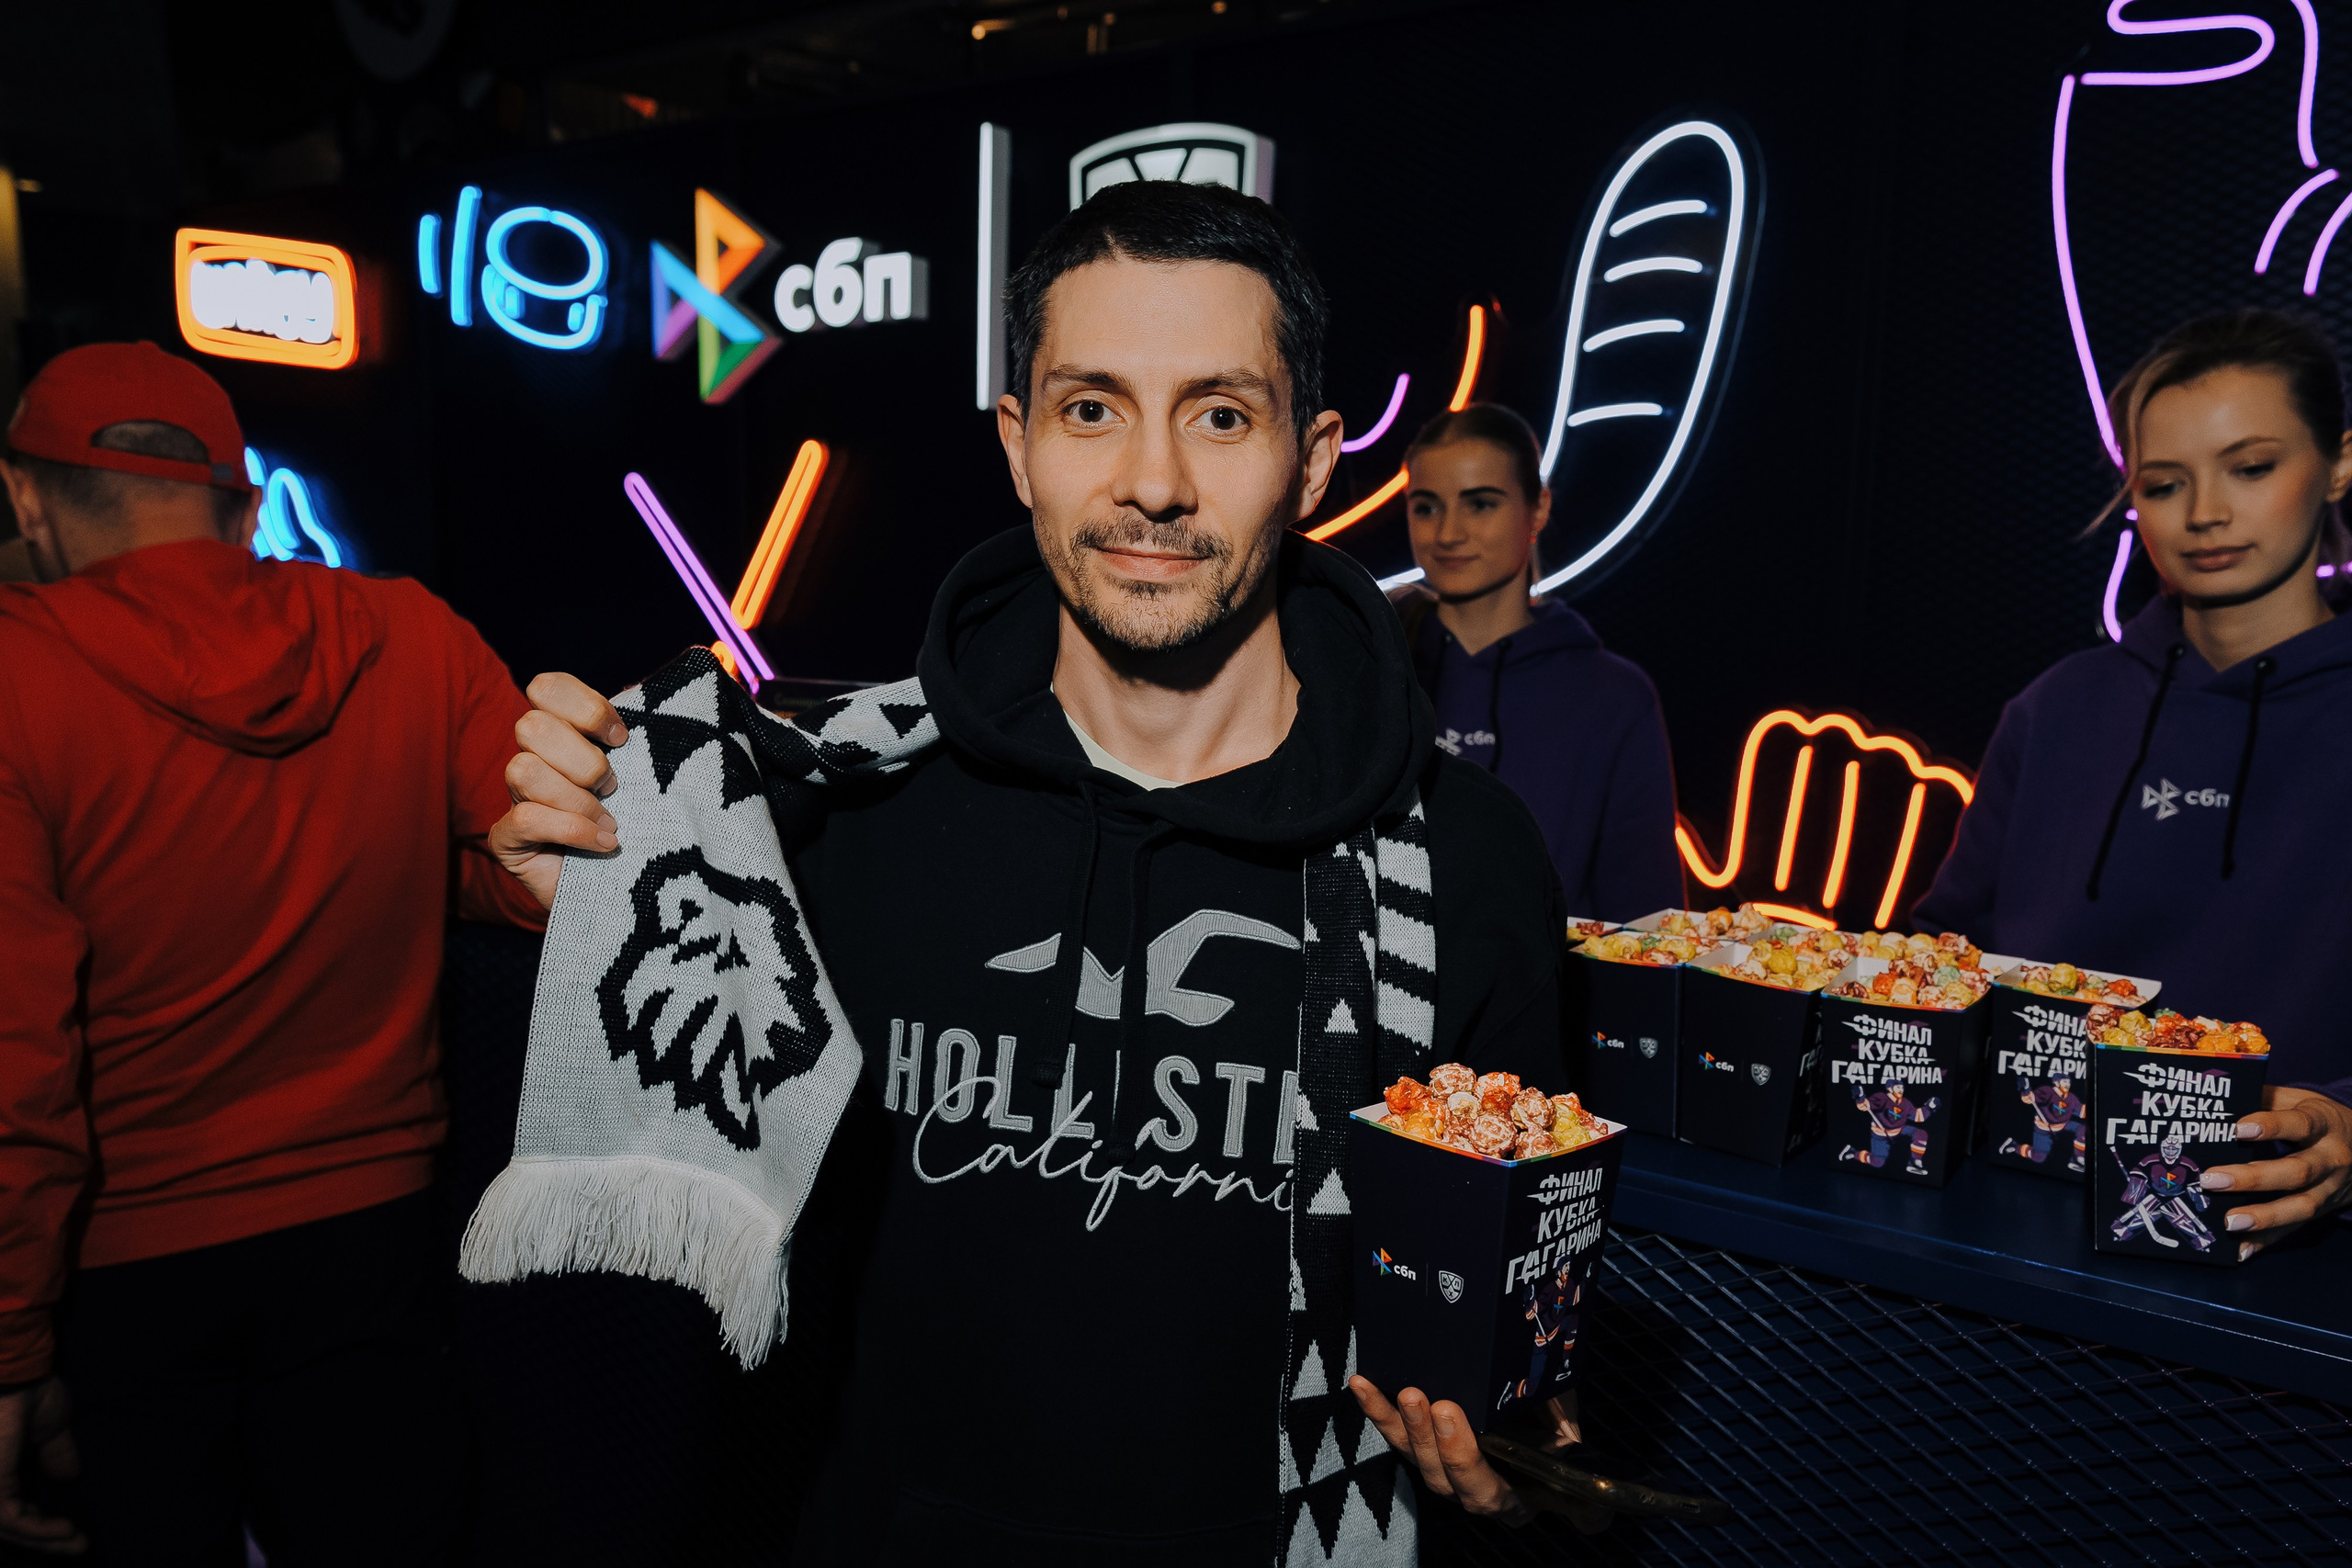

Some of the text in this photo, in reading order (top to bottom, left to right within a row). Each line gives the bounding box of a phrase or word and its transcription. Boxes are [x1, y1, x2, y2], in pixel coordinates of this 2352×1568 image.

[774, 237, 911, 333] сбп
[2184, 788, 2231, 808] сбп
[1606, 1038, 1625, 1049] сбп
[1841, 1014, 1932, 1046] ФИНАЛ
[1714, 1061, 1735, 1073] сбп
[1858, 1038, 1936, 1066] КУБКА
[1831, 1060, 1943, 1087] ГАГАРИНА
[2122, 1063, 2232, 1098] ФИНАЛ
[2141, 1090, 2234, 1121] КУБКА
[1526, 1168, 1603, 1206] ФИНАЛ
[1536, 1196, 1602, 1244] КУБКА
[1504, 1218, 1601, 1295] ГАГАРИНА
[1393, 1264, 1417, 1281] сбп
